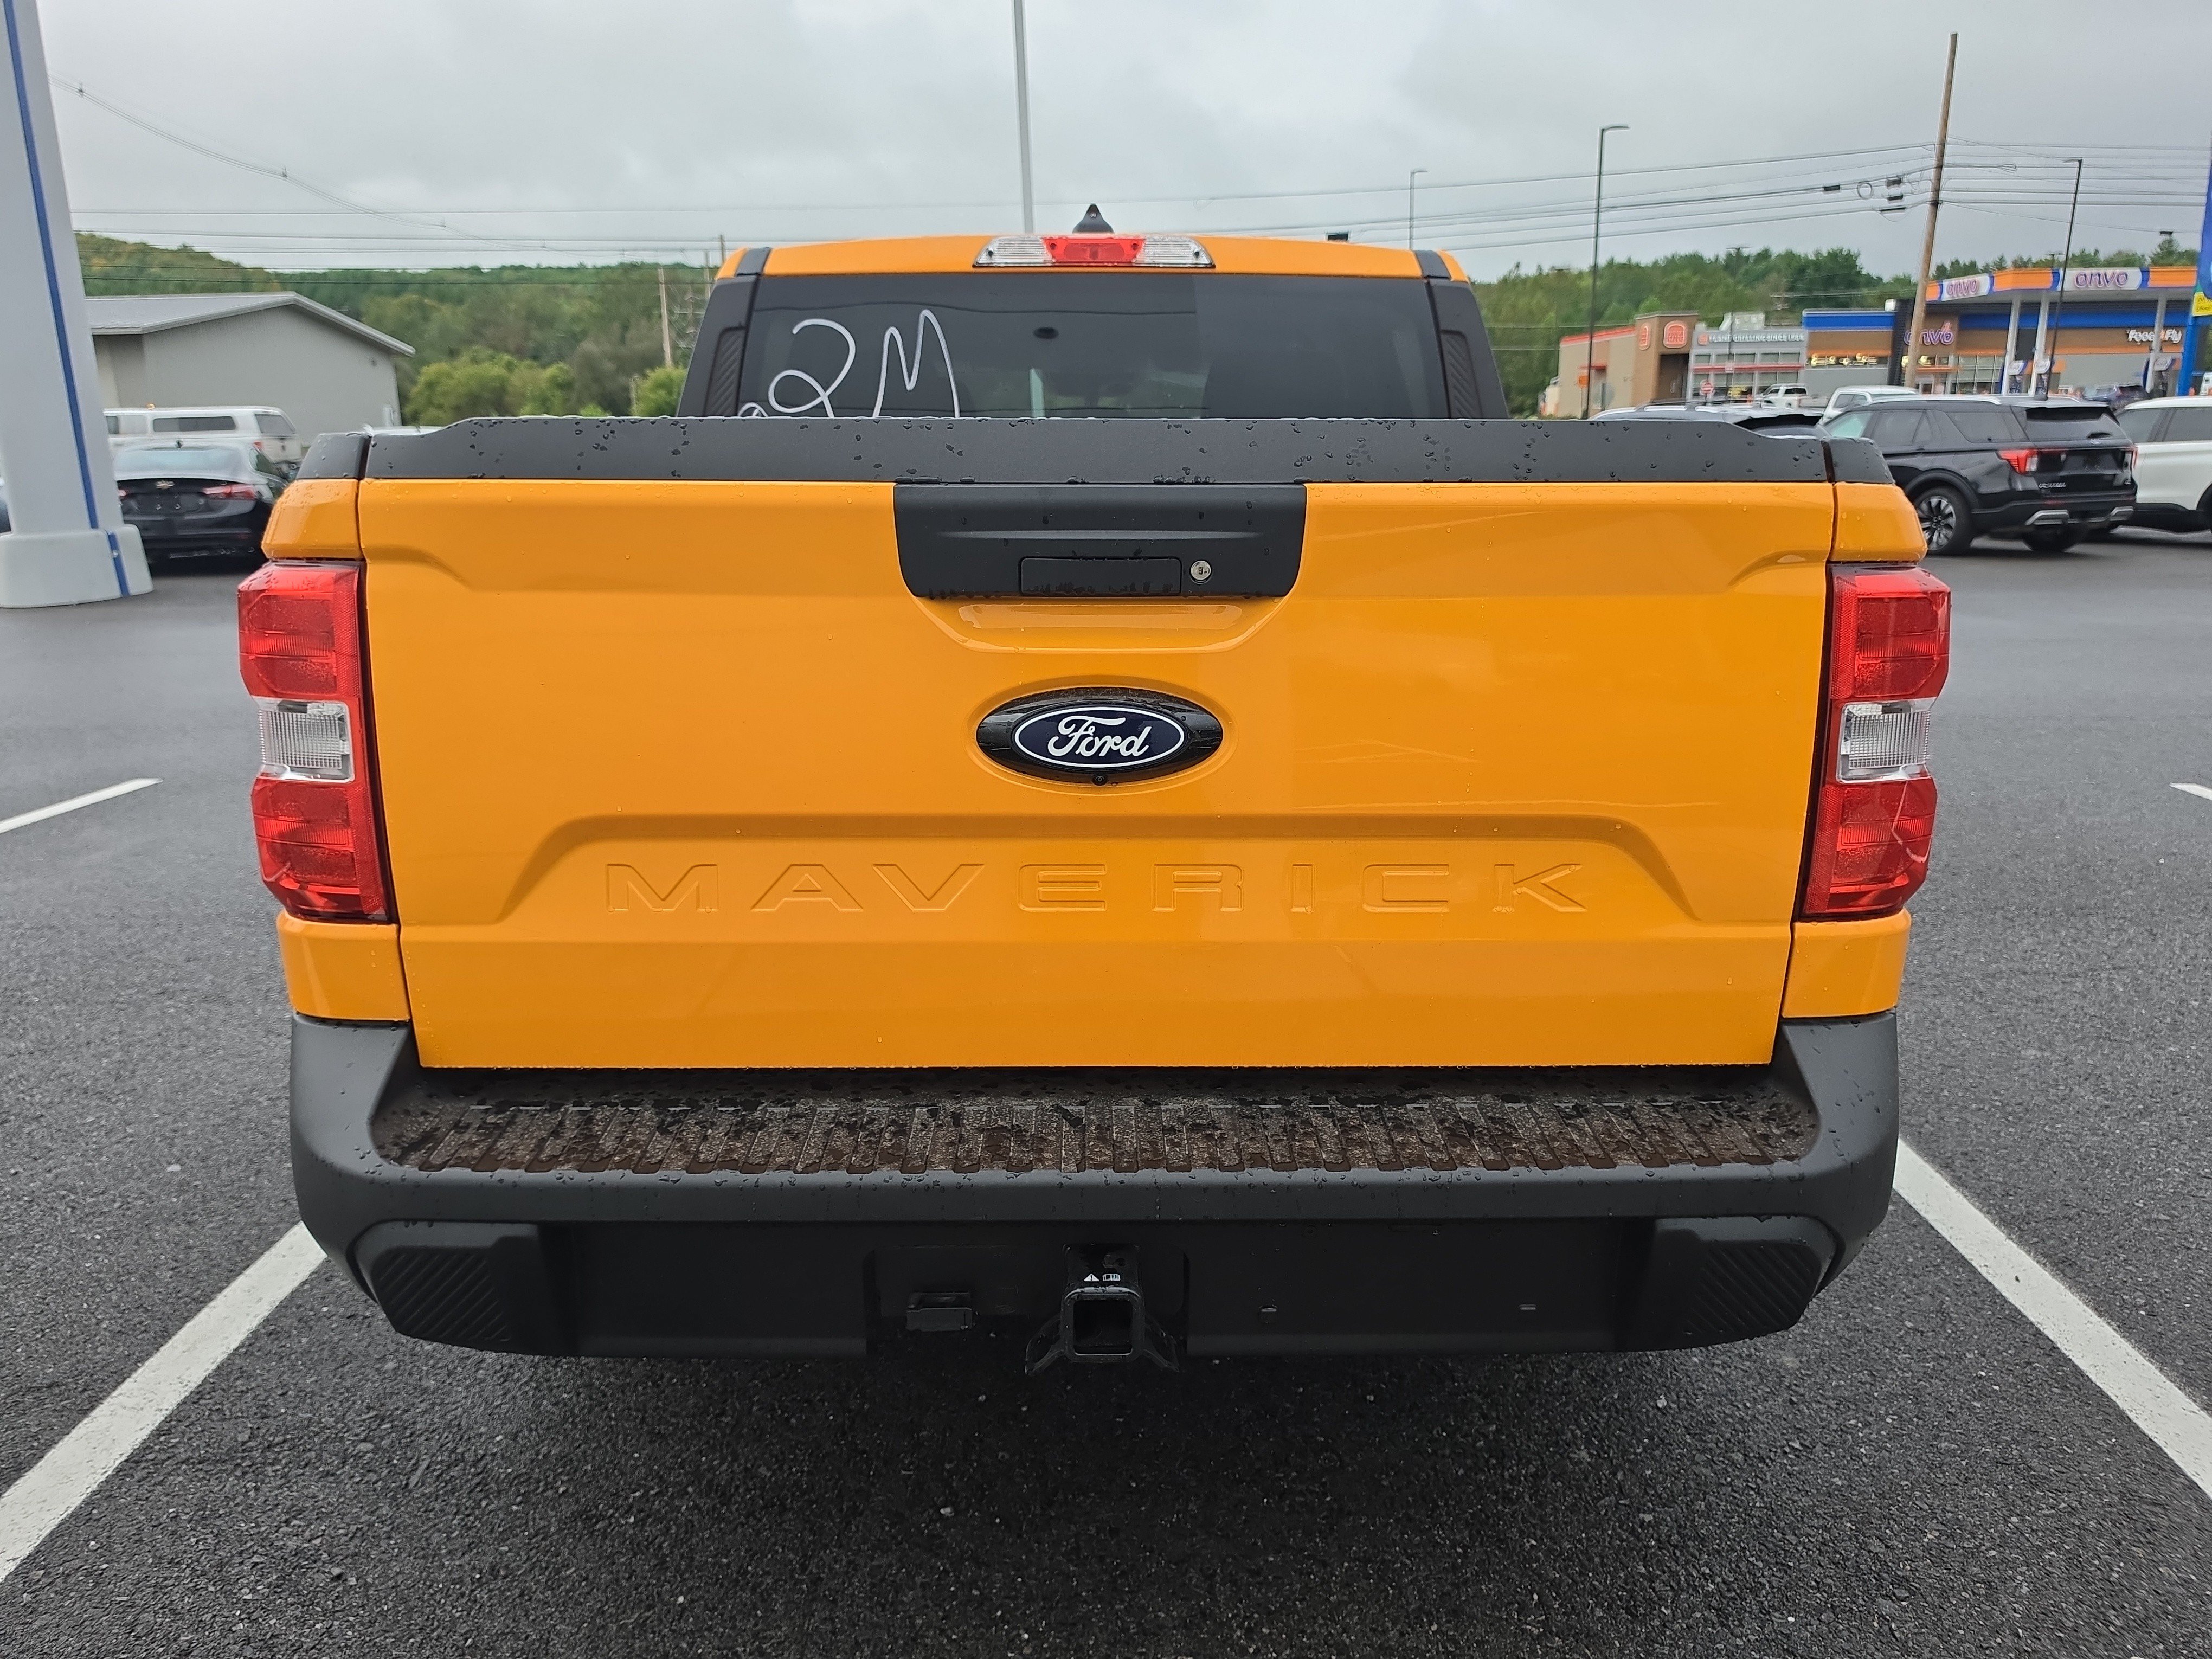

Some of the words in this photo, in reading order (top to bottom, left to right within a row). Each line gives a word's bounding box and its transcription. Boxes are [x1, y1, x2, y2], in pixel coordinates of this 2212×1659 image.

[1946, 278, 1979, 297] onvo
[2075, 271, 2129, 288] onvo
[1047, 715, 1153, 756] Ford
[606, 863, 1587, 913] MAVERICK
